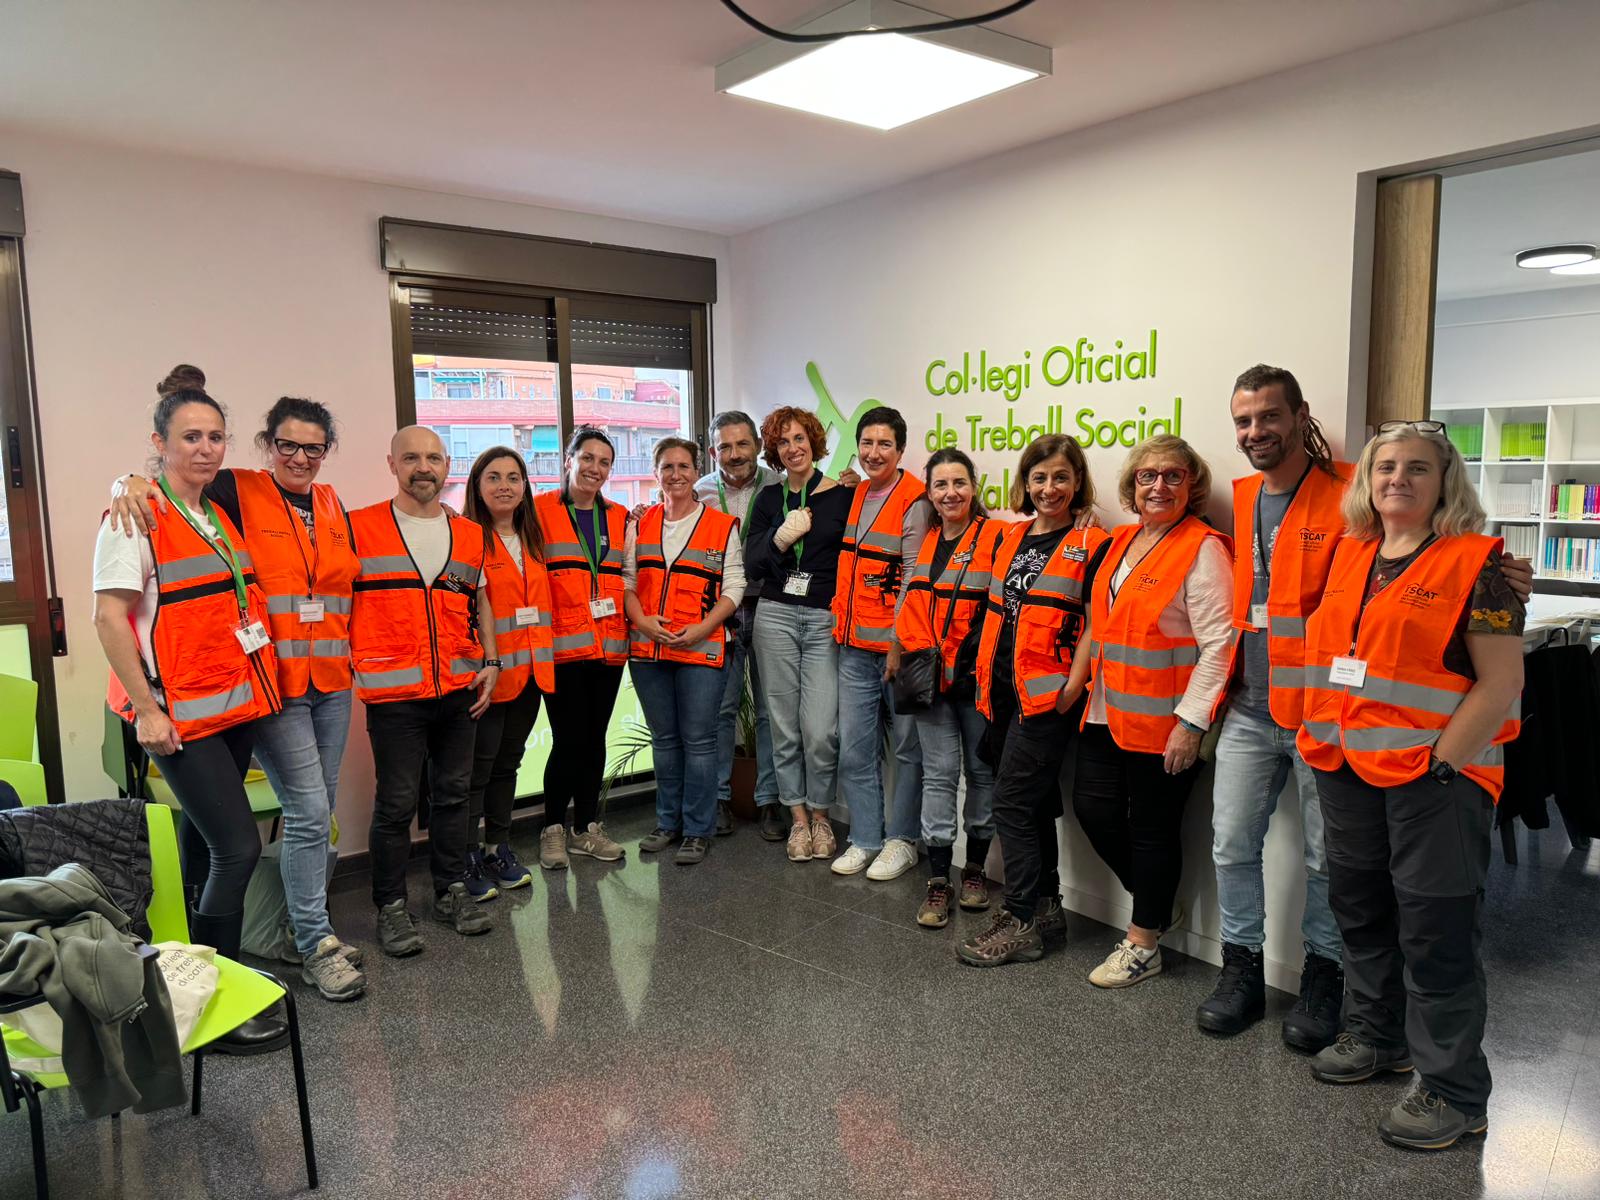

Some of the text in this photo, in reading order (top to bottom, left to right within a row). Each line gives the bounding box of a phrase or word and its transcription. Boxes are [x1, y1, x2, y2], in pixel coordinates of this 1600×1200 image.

[925, 329, 1158, 401] Col·legi Oficial
[925, 412, 958, 452] de
[1299, 531, 1327, 542] TSCAT
[1404, 585, 1439, 600] TSCAT
